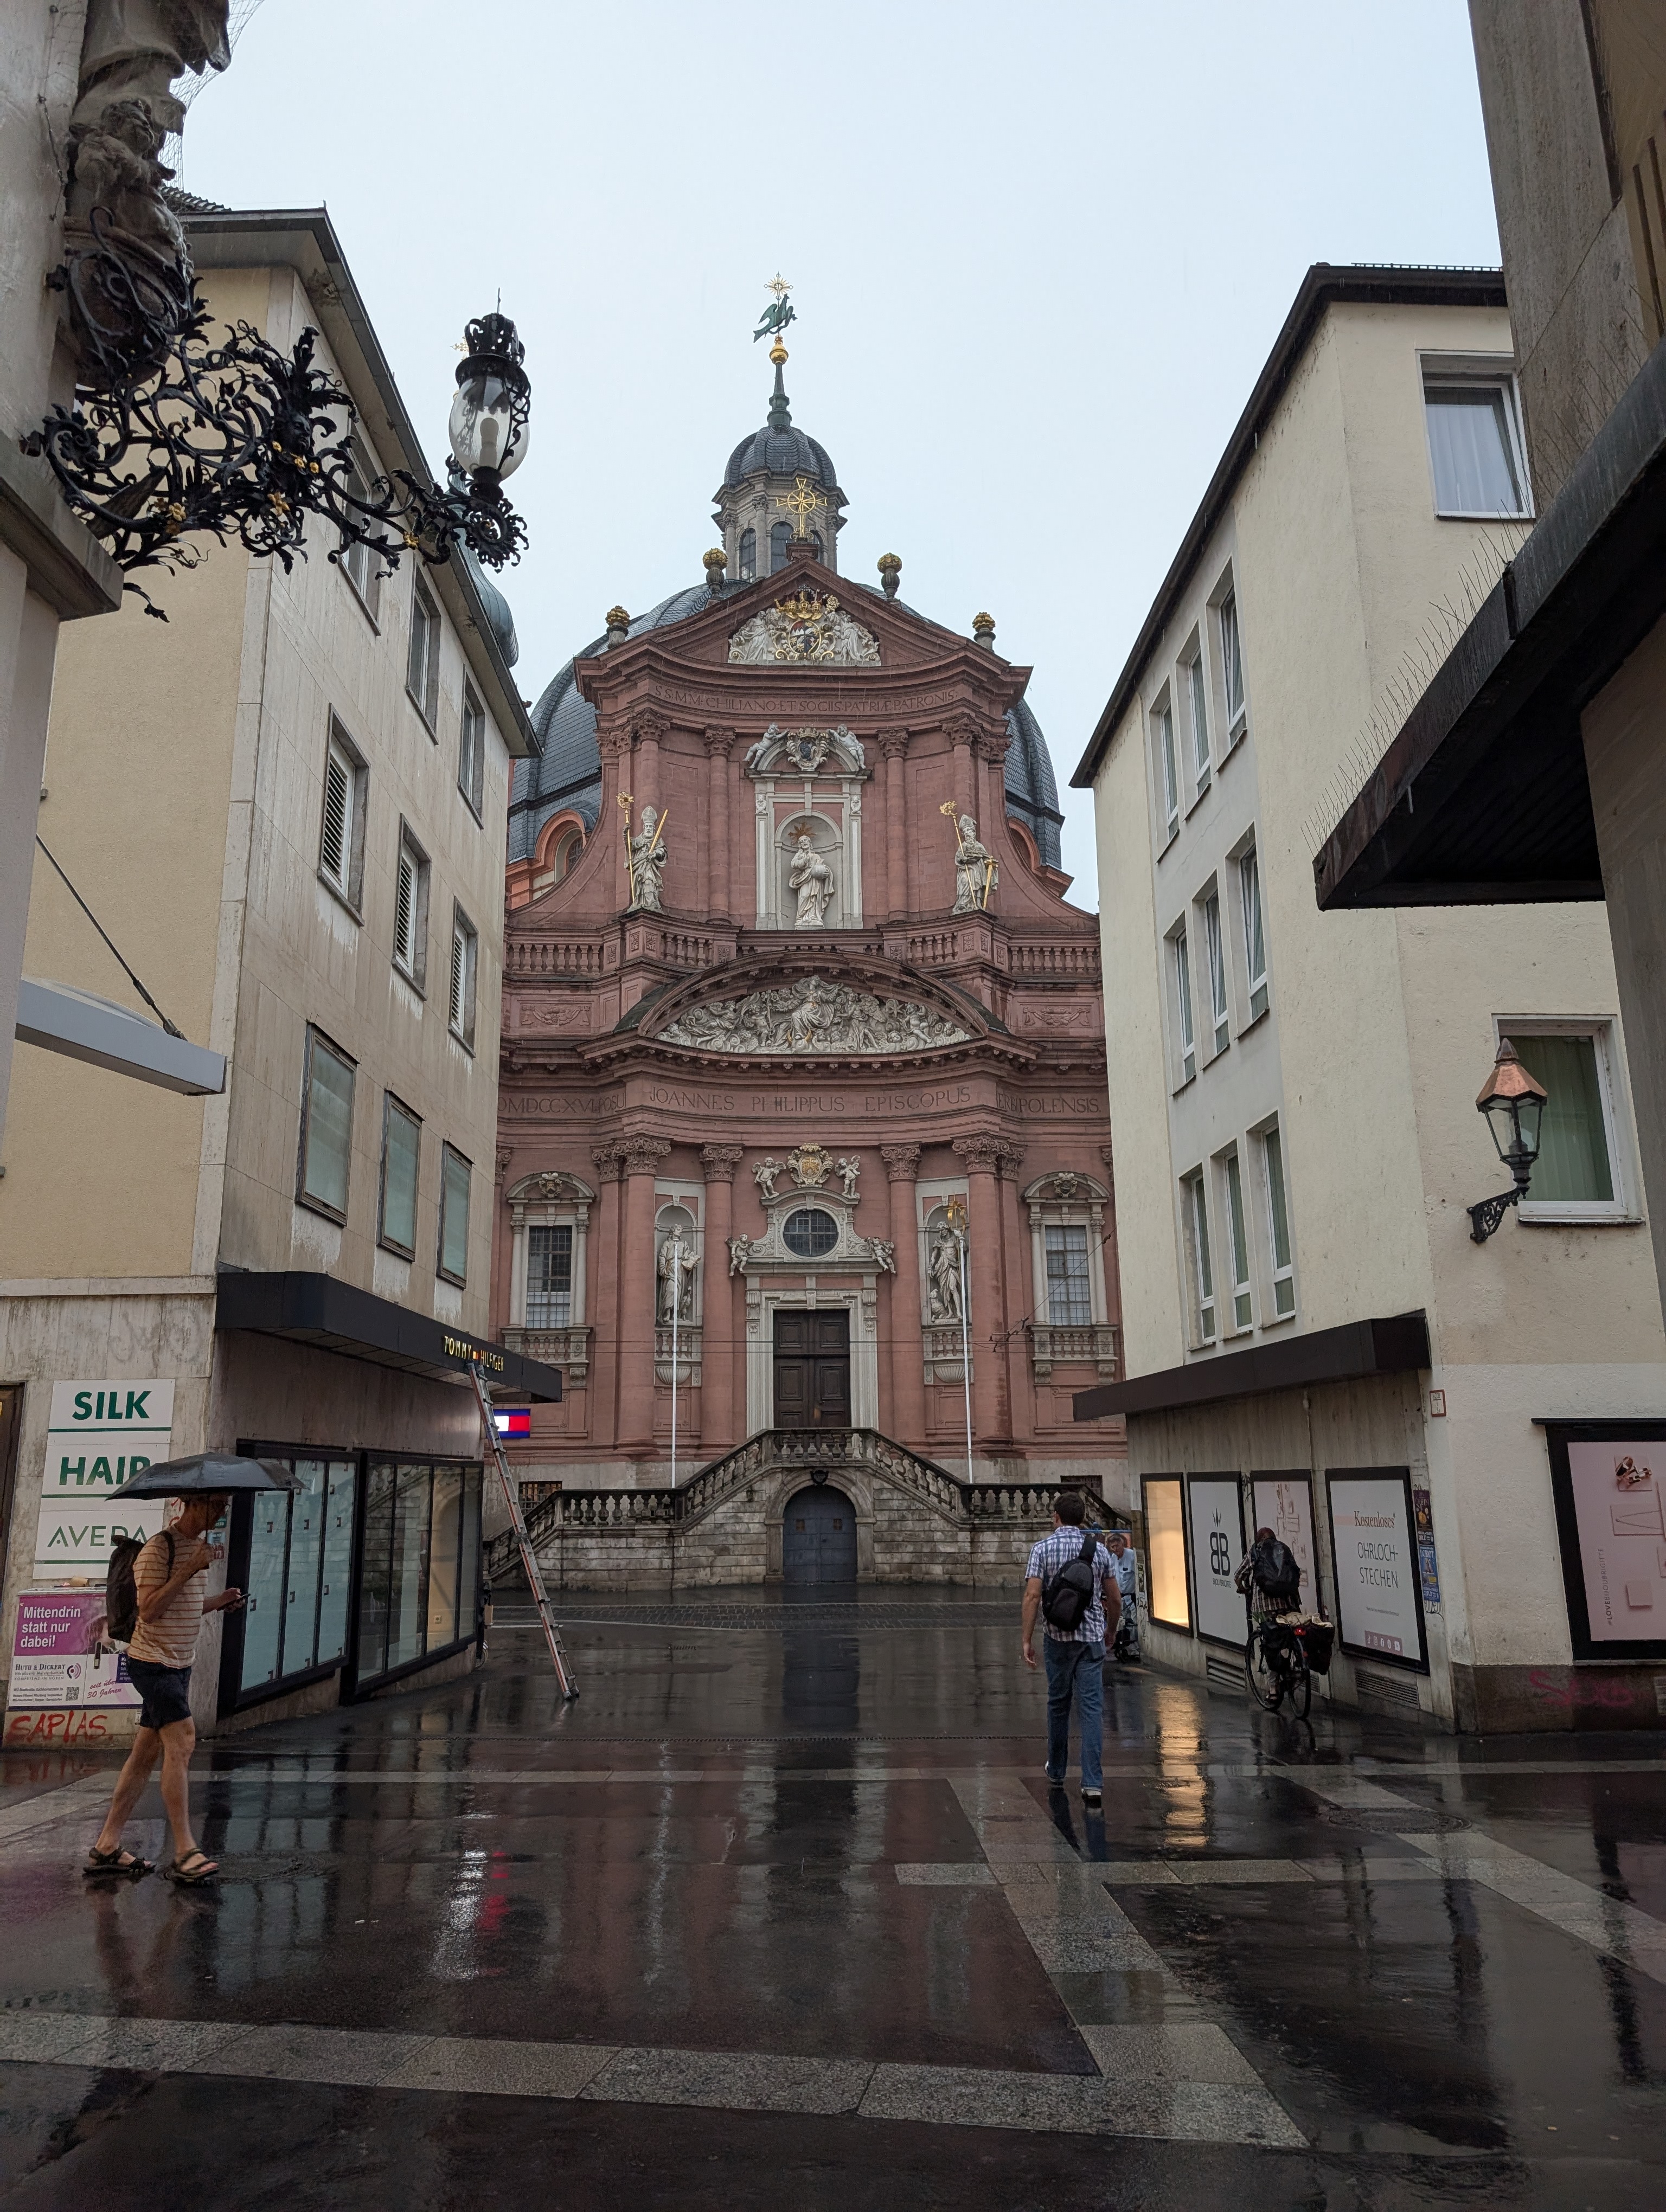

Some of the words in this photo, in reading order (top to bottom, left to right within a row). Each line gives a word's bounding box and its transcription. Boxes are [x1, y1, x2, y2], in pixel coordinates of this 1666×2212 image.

[650, 1086, 735, 1111] JOANNES
[752, 1096, 845, 1113] PHILIPPUS
[864, 1086, 971, 1112] EPISCOPUS
[444, 1335, 472, 1360] TOMMY
[480, 1349, 504, 1372] HILFIGER
[72, 1390, 152, 1420] SILK
[1357, 1541, 1399, 1562] OHRLOCH-
[1360, 1566, 1399, 1589] STECHEN
[23, 1605, 81, 1619] Mittendrin
[22, 1622, 47, 1633] statt
[50, 1622, 71, 1632] nur
[20, 1635, 56, 1648] dabei!
[99, 1687, 122, 1699] Jahren
